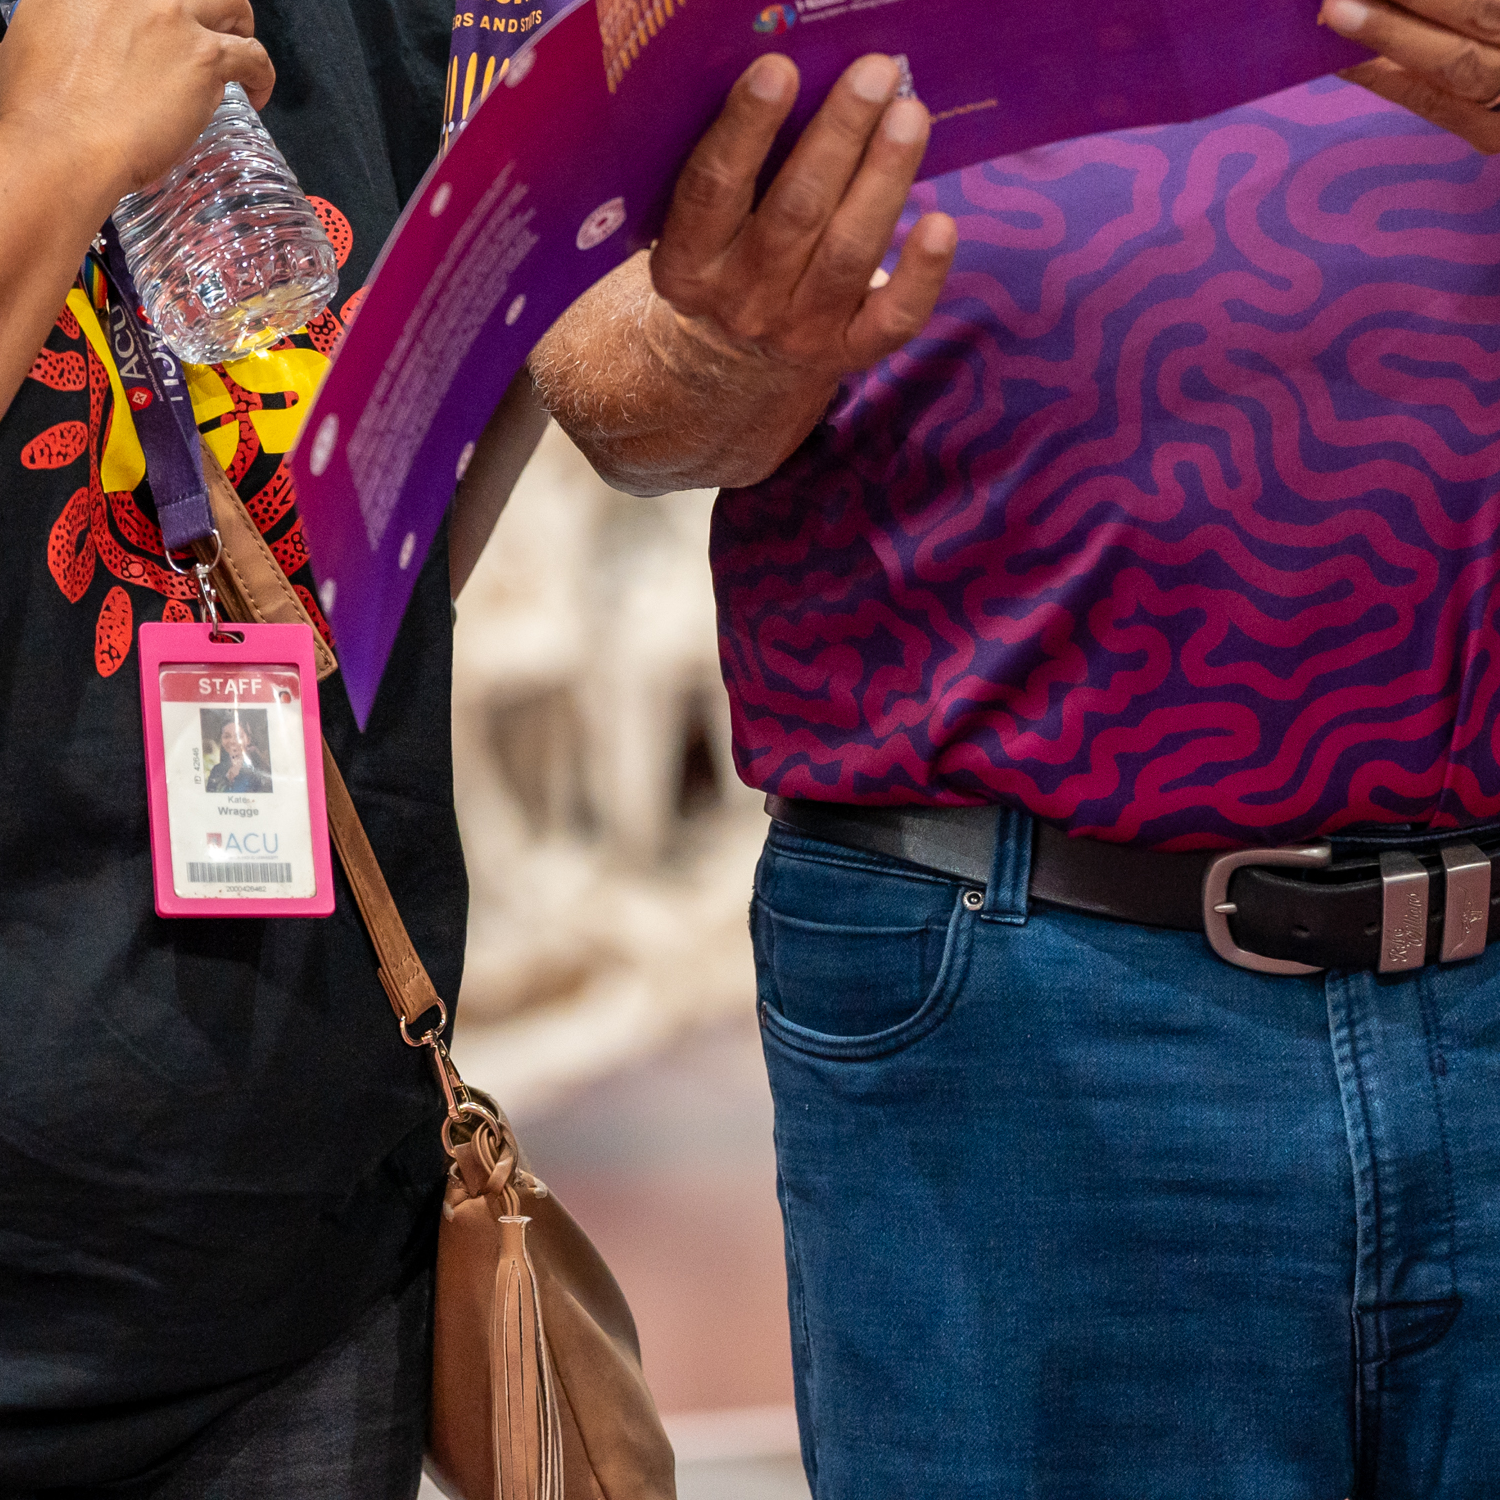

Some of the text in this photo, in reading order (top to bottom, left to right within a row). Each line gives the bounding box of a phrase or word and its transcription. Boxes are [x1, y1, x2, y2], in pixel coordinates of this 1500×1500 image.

[480, 14, 519, 33] AND
[111, 304, 147, 380] ACU
[198, 677, 262, 695] STAFF
[217, 806, 260, 818] Wragge
[225, 832, 279, 854] ACU
